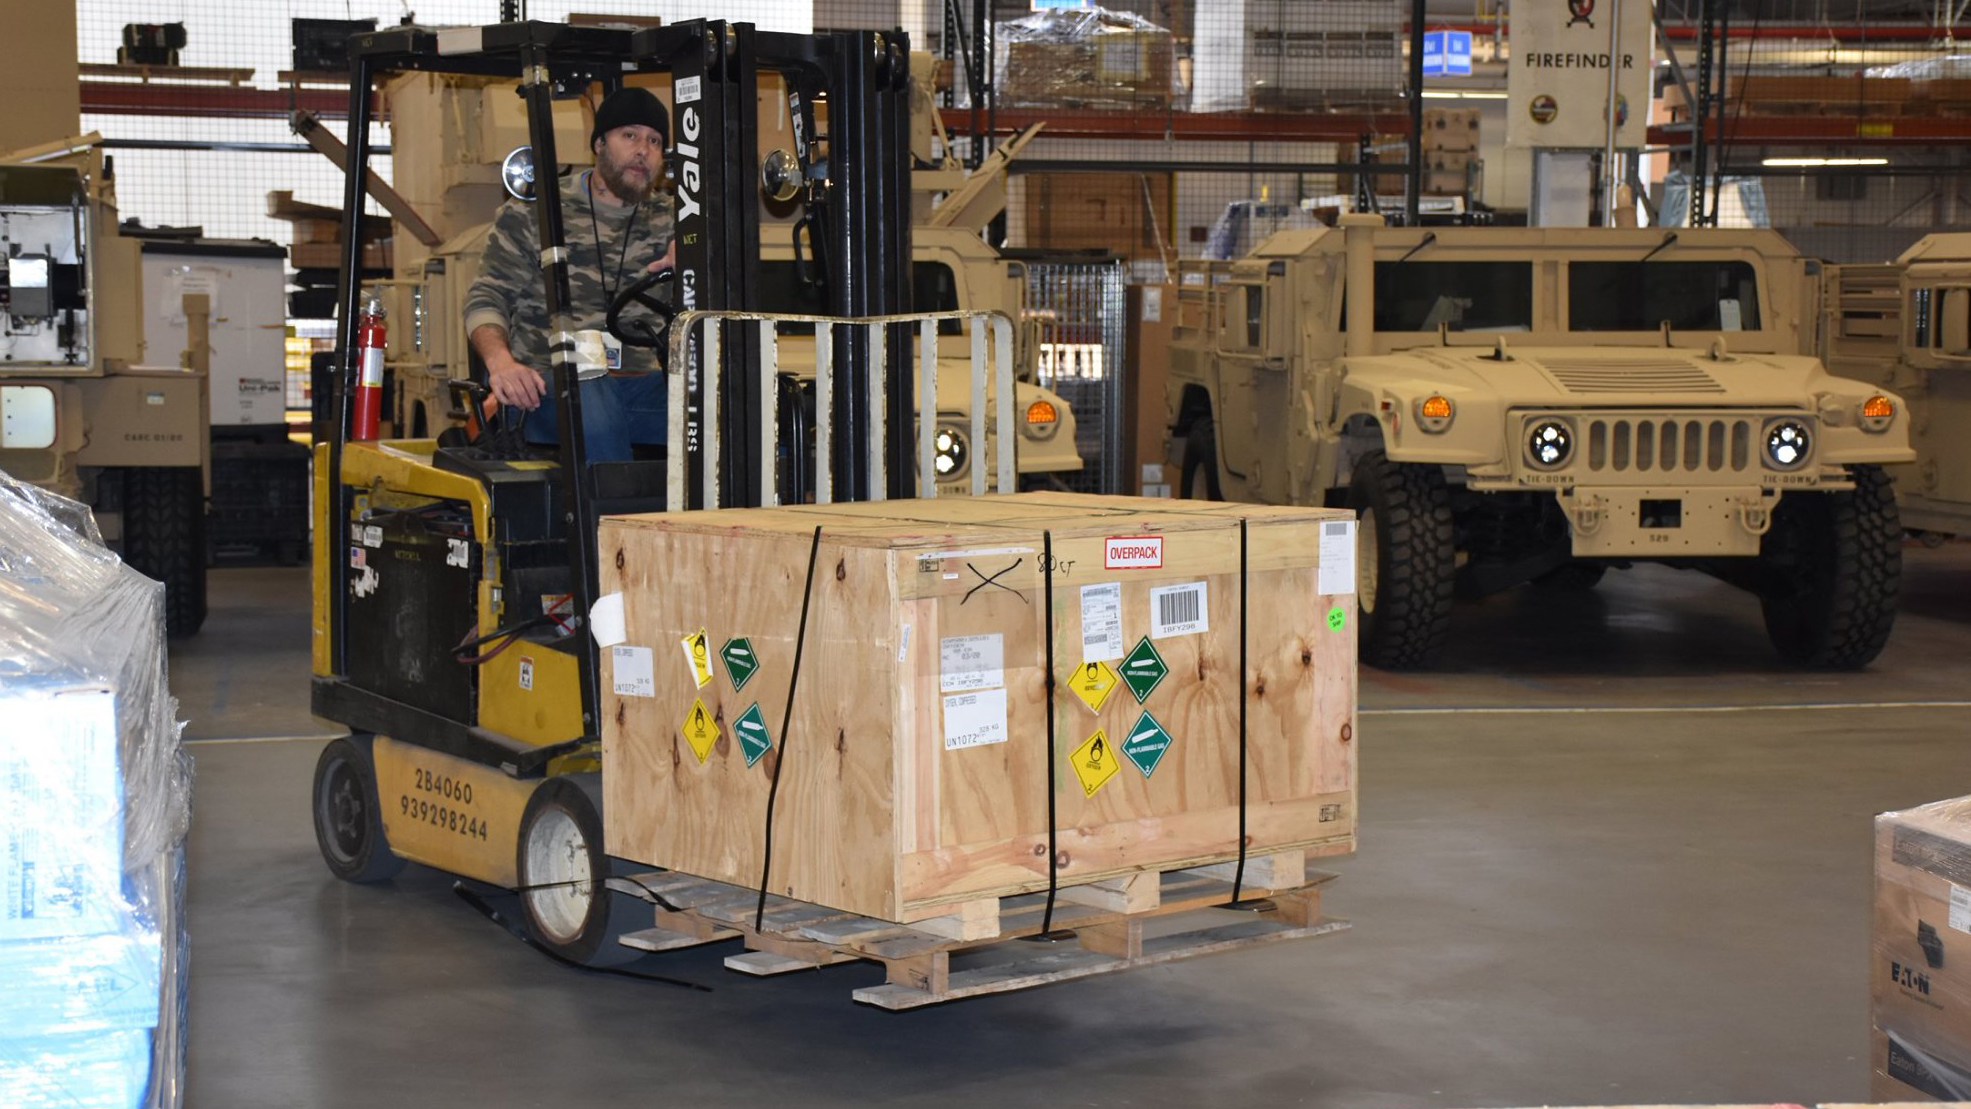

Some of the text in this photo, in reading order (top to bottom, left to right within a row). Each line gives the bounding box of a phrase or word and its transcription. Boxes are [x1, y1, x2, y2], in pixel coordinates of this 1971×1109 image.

[1526, 53, 1633, 69] FIREFINDR
[677, 106, 700, 222] Yale
[1526, 474, 1575, 484] TIE-DOWN
[1762, 474, 1812, 484] TIE-DOWN
[1110, 546, 1158, 560] OVERPACK
[946, 733, 978, 747] UN1072
[415, 768, 472, 805] 2B4060
[401, 794, 487, 842] 939298244
[1891, 961, 1930, 995] EATON
